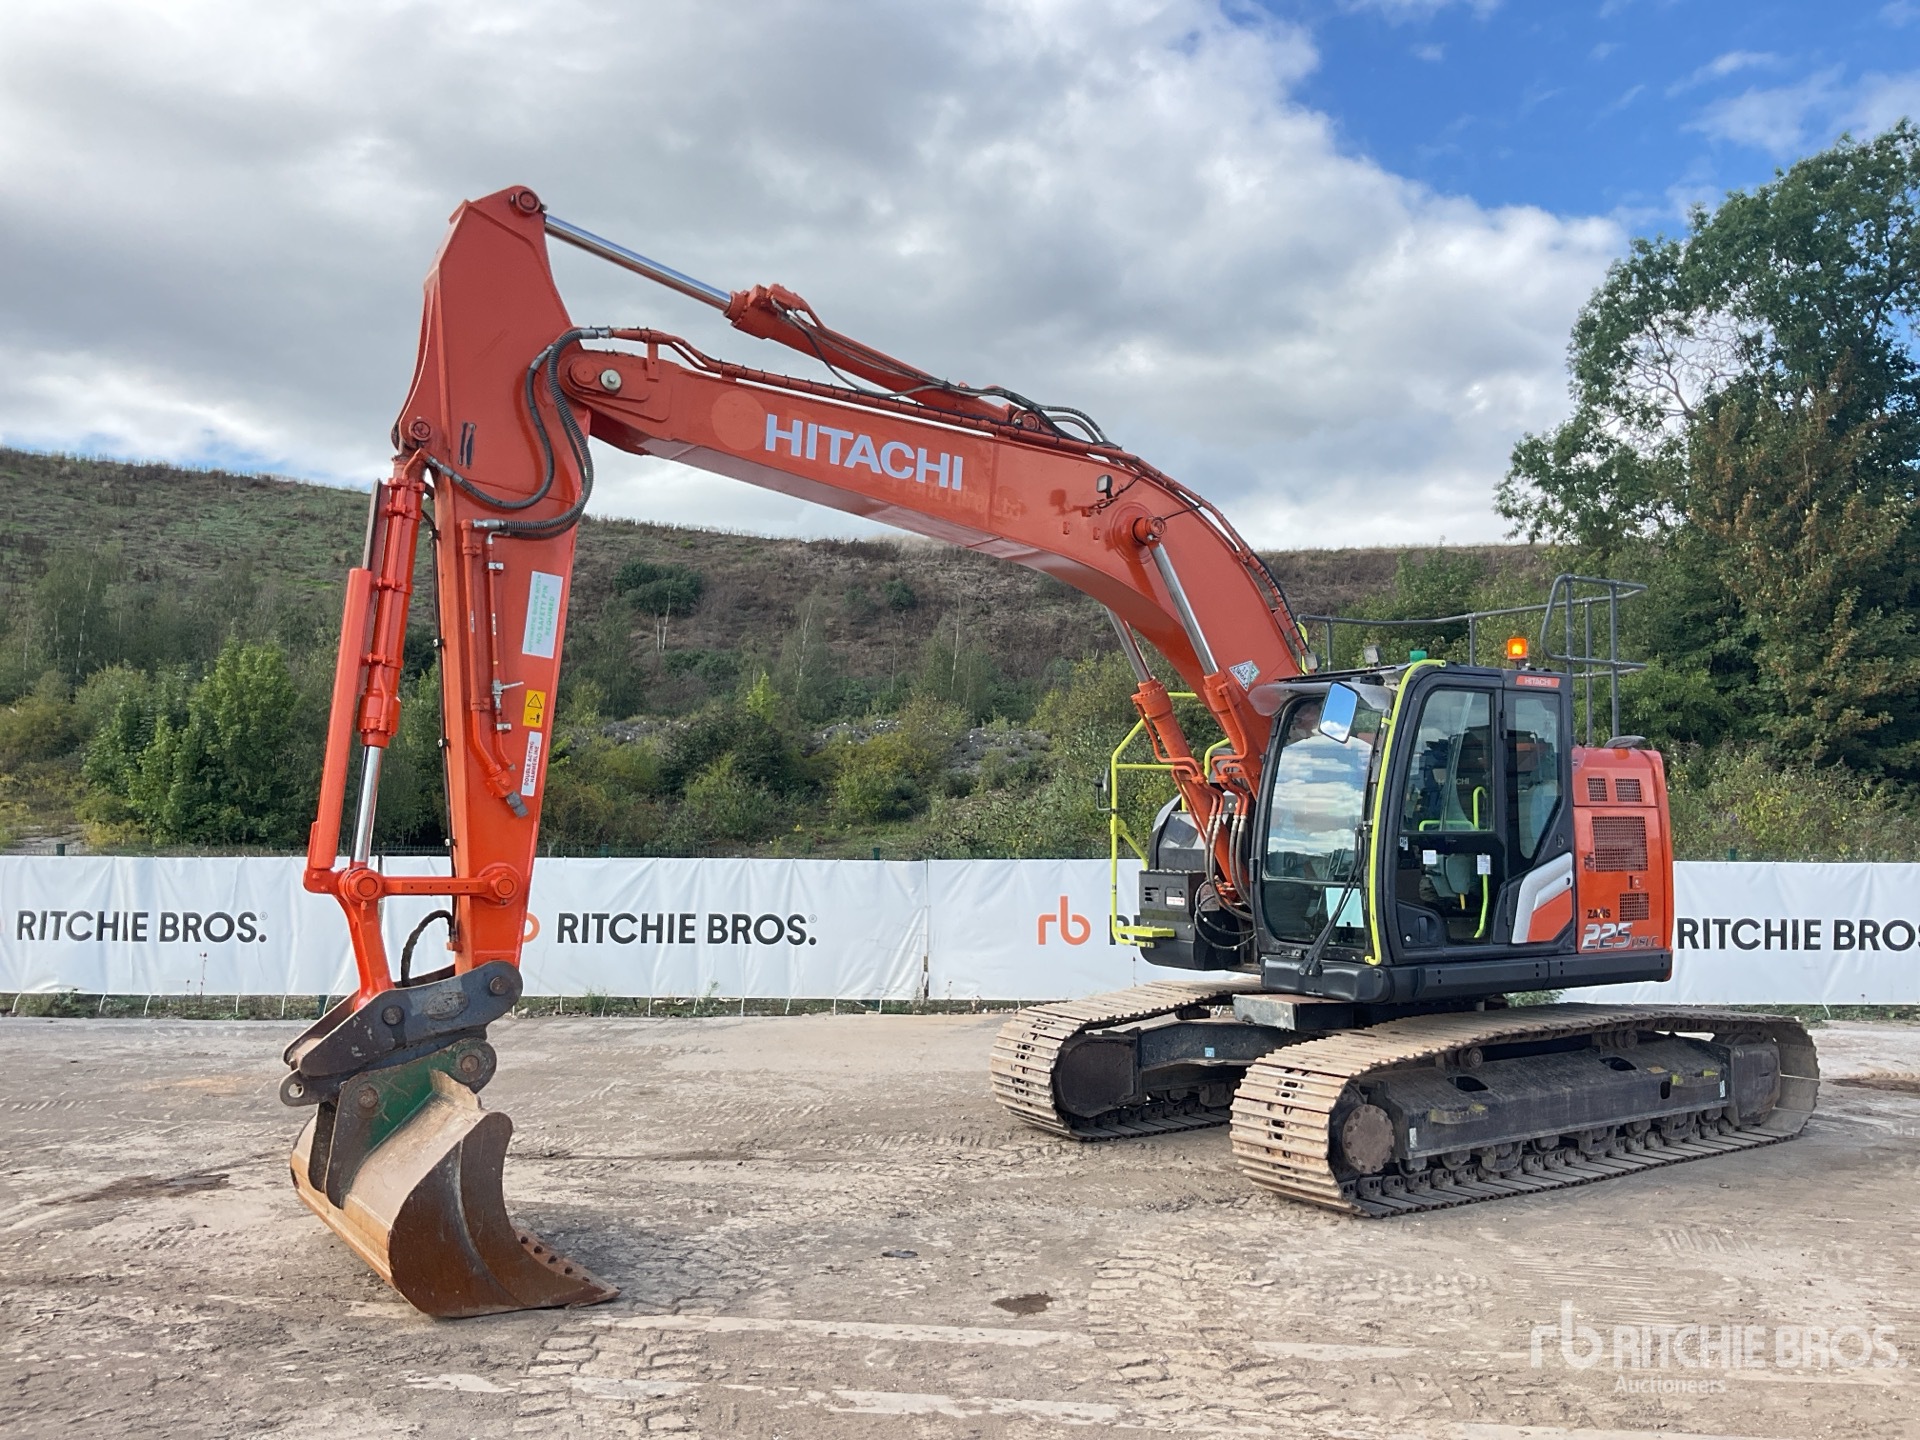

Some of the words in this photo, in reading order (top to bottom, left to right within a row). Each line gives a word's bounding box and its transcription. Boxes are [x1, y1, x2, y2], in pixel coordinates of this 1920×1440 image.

[765, 414, 963, 491] HITACHI
[531, 596, 539, 614] QUICK
[541, 585, 549, 599] PIN
[537, 601, 547, 631] SAFETY
[544, 596, 555, 637] REQUIRED
[535, 633, 543, 644] NO
[1524, 677, 1552, 686] HITACHI
[527, 741, 535, 762] ACTING
[530, 746, 539, 783] HAMMERLINE
[524, 763, 532, 786] DOUBLE
[1587, 906, 1611, 919] ZAXIS
[16, 910, 149, 942] RITCHIE
[158, 911, 267, 943] BROS.
[557, 912, 697, 945] RITCHIE
[707, 913, 817, 946] BROS.
[1676, 917, 1822, 951] RITCHIE
[1833, 918, 1920, 952] BRO
